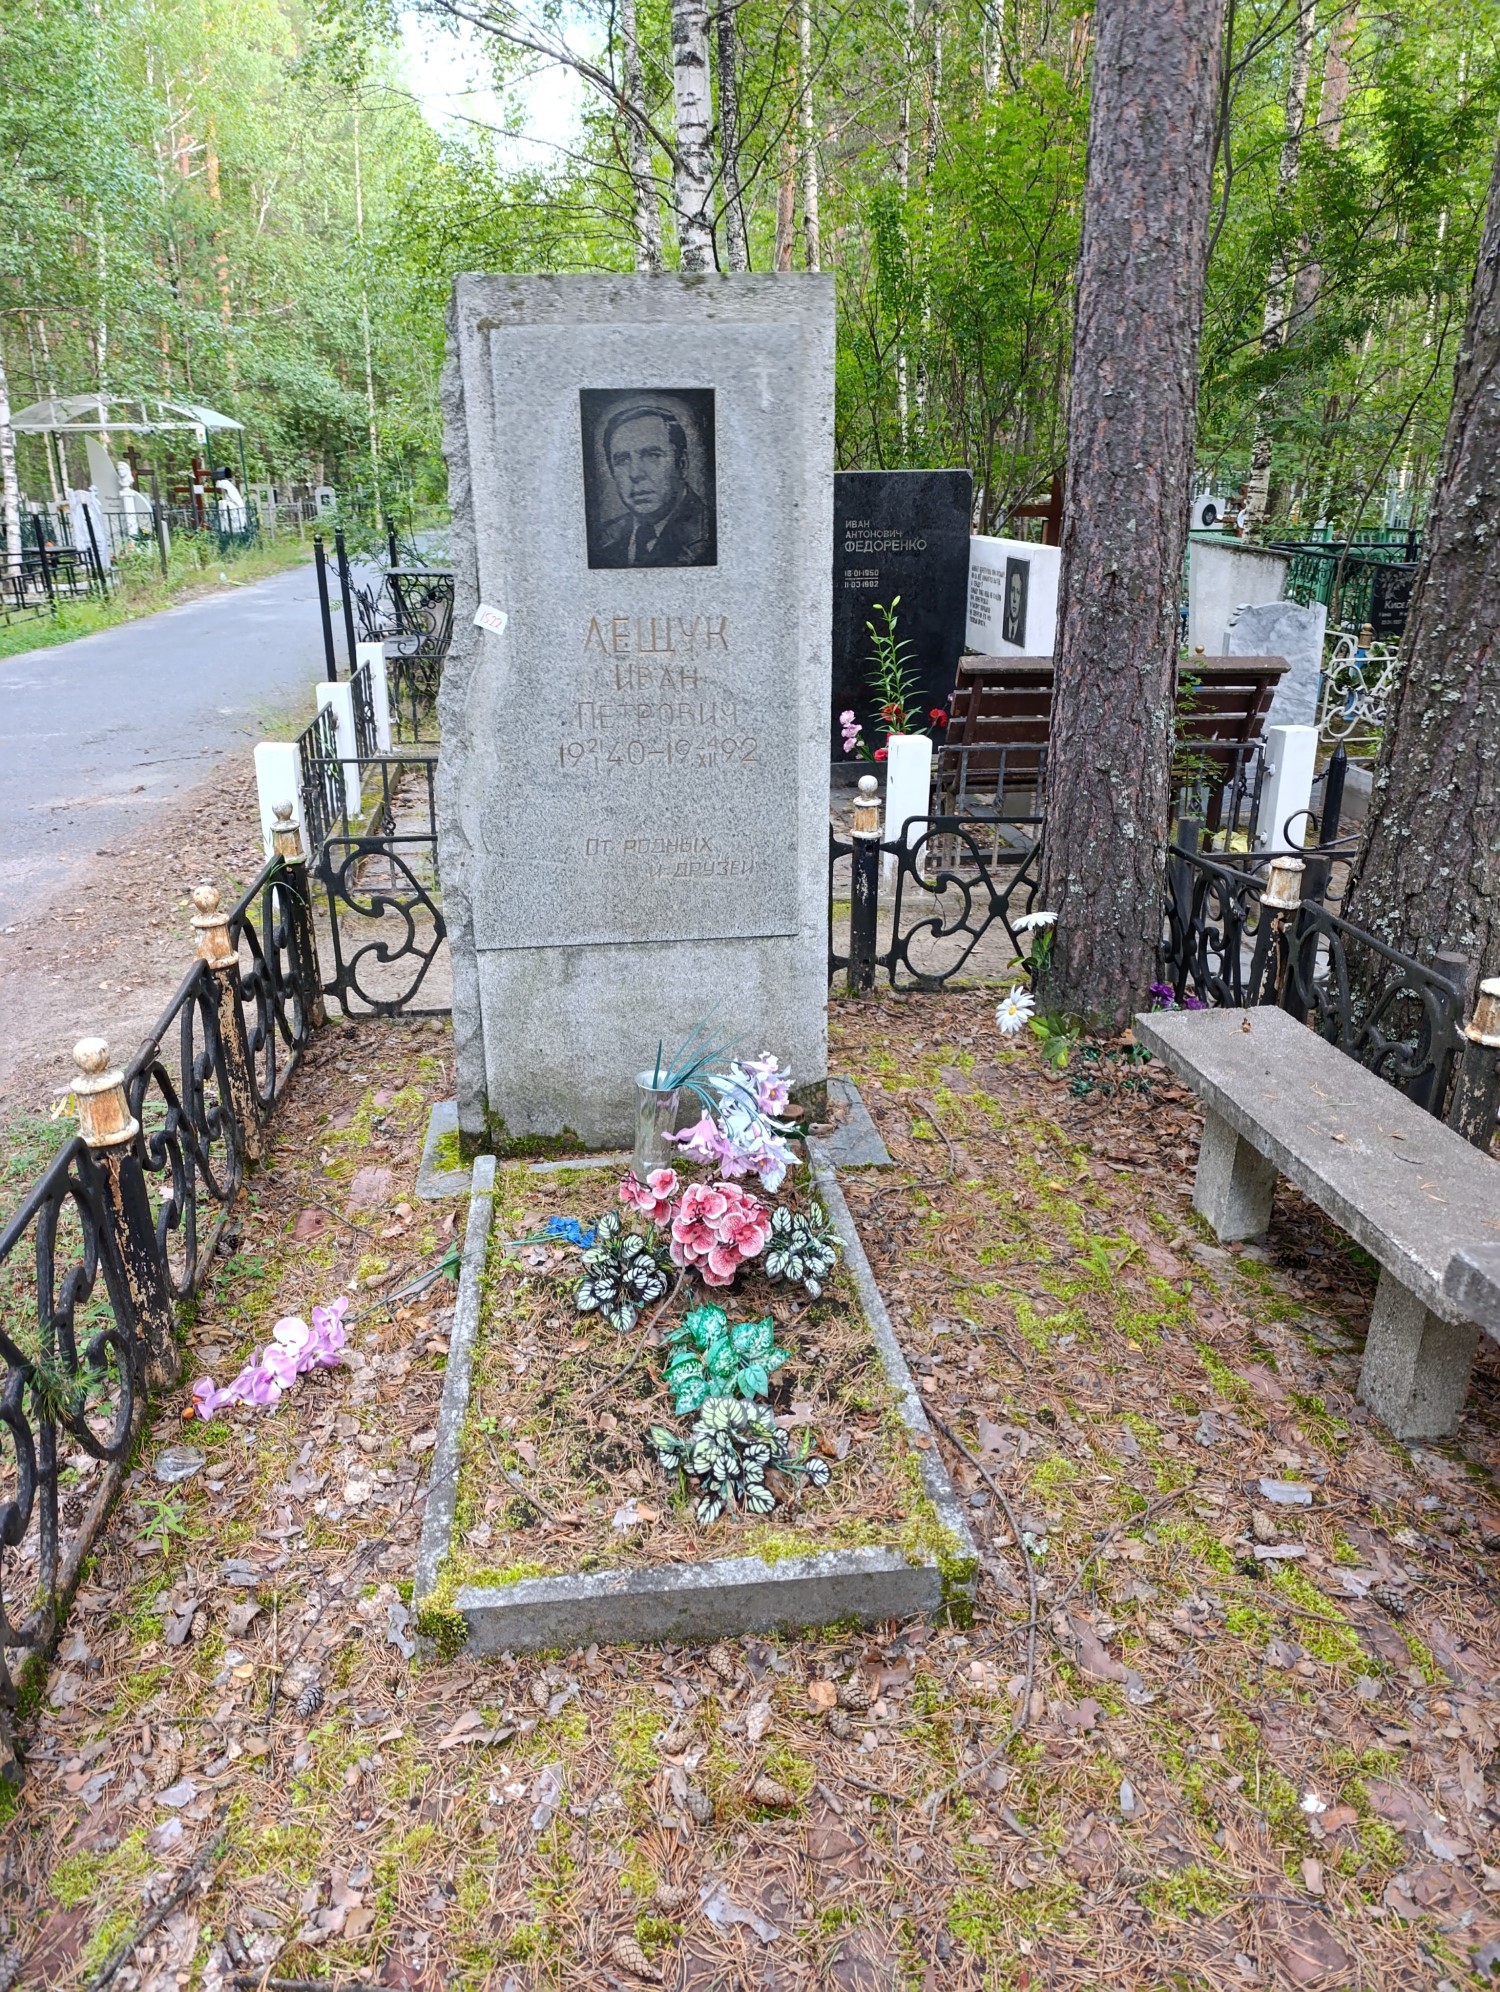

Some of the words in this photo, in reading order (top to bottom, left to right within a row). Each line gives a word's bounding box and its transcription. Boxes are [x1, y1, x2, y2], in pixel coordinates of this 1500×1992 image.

[845, 519, 870, 528] ИВАН
[845, 529, 902, 539] АНТОНОВИЧ
[844, 539, 927, 553] ФЕДОРЕНКО
[615, 663, 699, 691] ИВАН
[577, 701, 739, 730] ПЕТРОВИЧ
[586, 838, 613, 856] ОТ
[624, 837, 713, 855] РОДНЫХ
